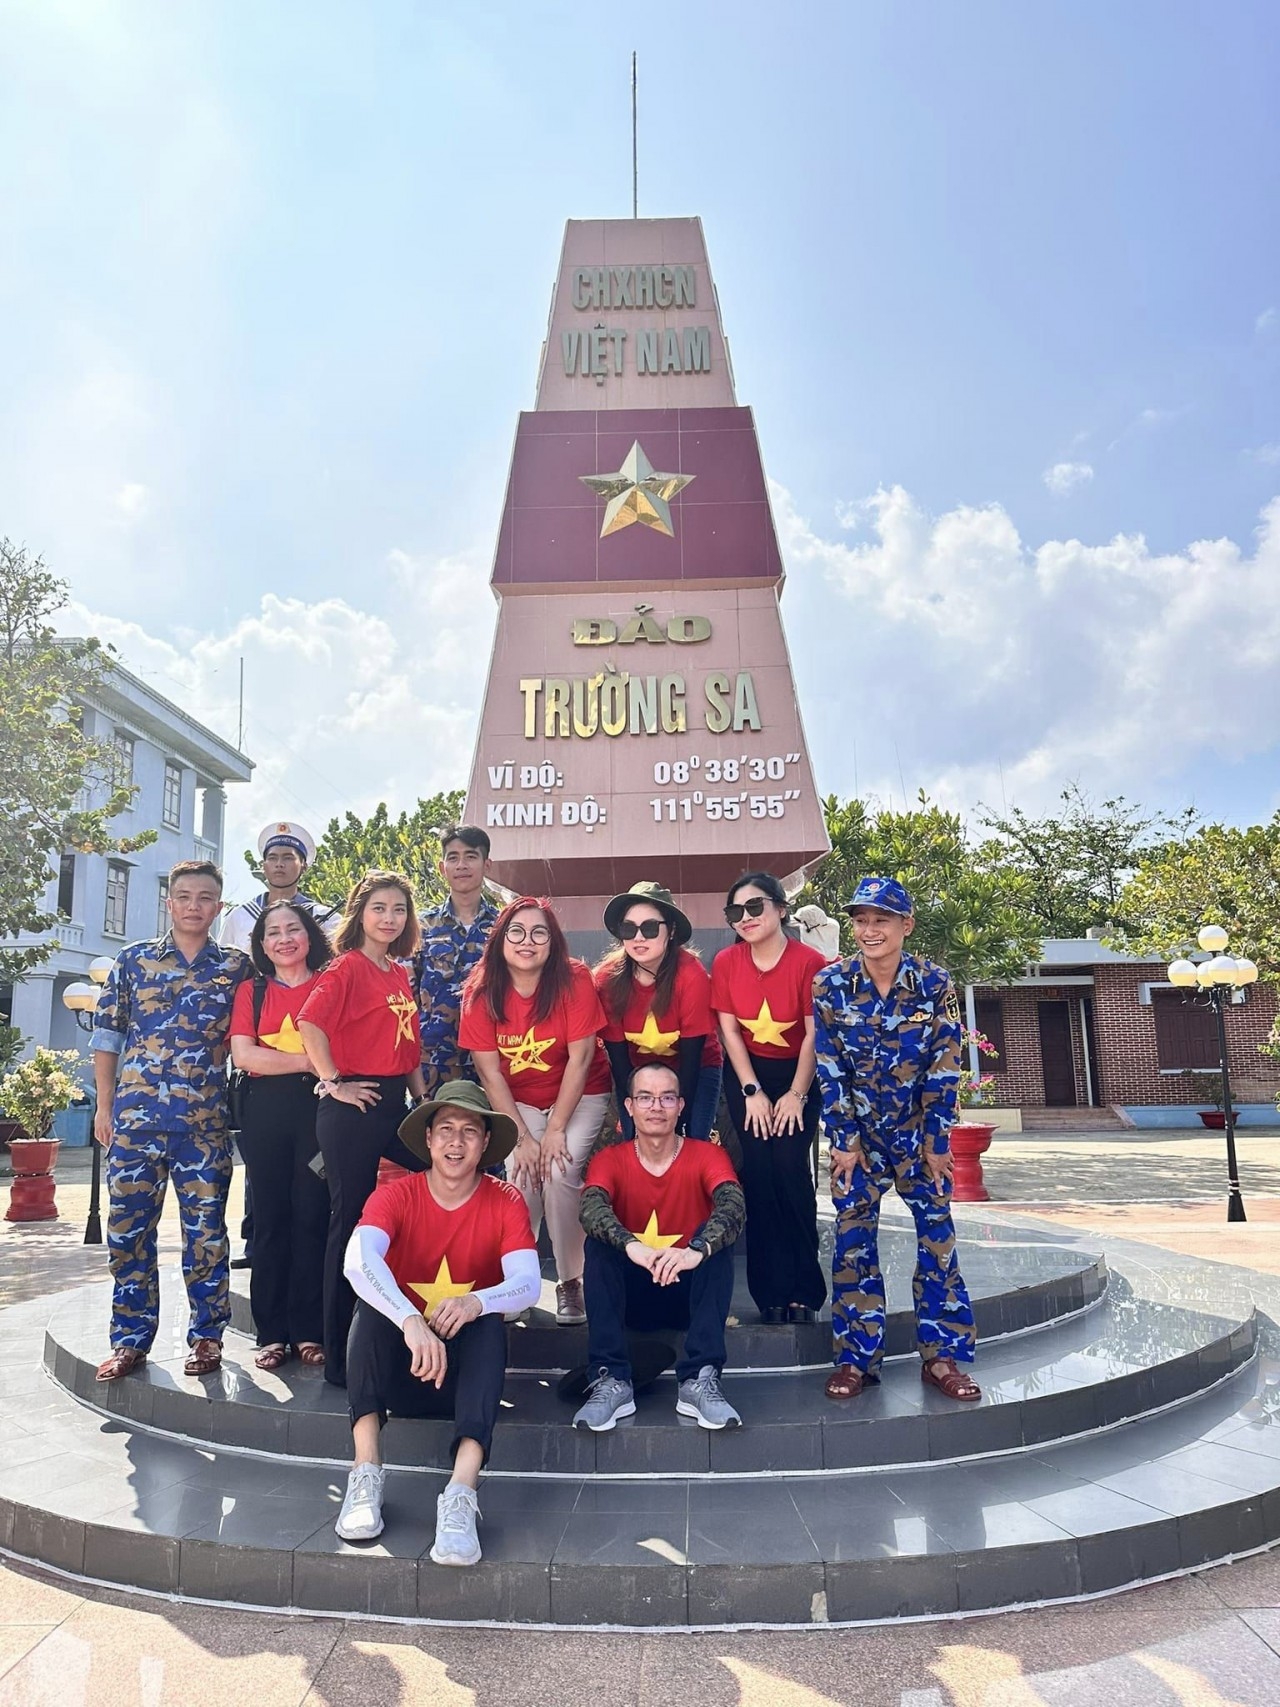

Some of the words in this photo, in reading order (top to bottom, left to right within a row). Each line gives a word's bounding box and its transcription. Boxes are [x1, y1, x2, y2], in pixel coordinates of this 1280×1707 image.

[572, 265, 696, 311] CHXHCN
[561, 322, 627, 387] VIỆT
[636, 325, 711, 376] NAM
[570, 602, 712, 646] ĐẢO
[519, 661, 688, 739] TRƯỜNG
[704, 671, 762, 734] SA
[487, 759, 516, 790] VĨ
[520, 760, 564, 794] ĐỘ:
[486, 801, 553, 828] KINH
[561, 794, 607, 833] ĐỘ:
